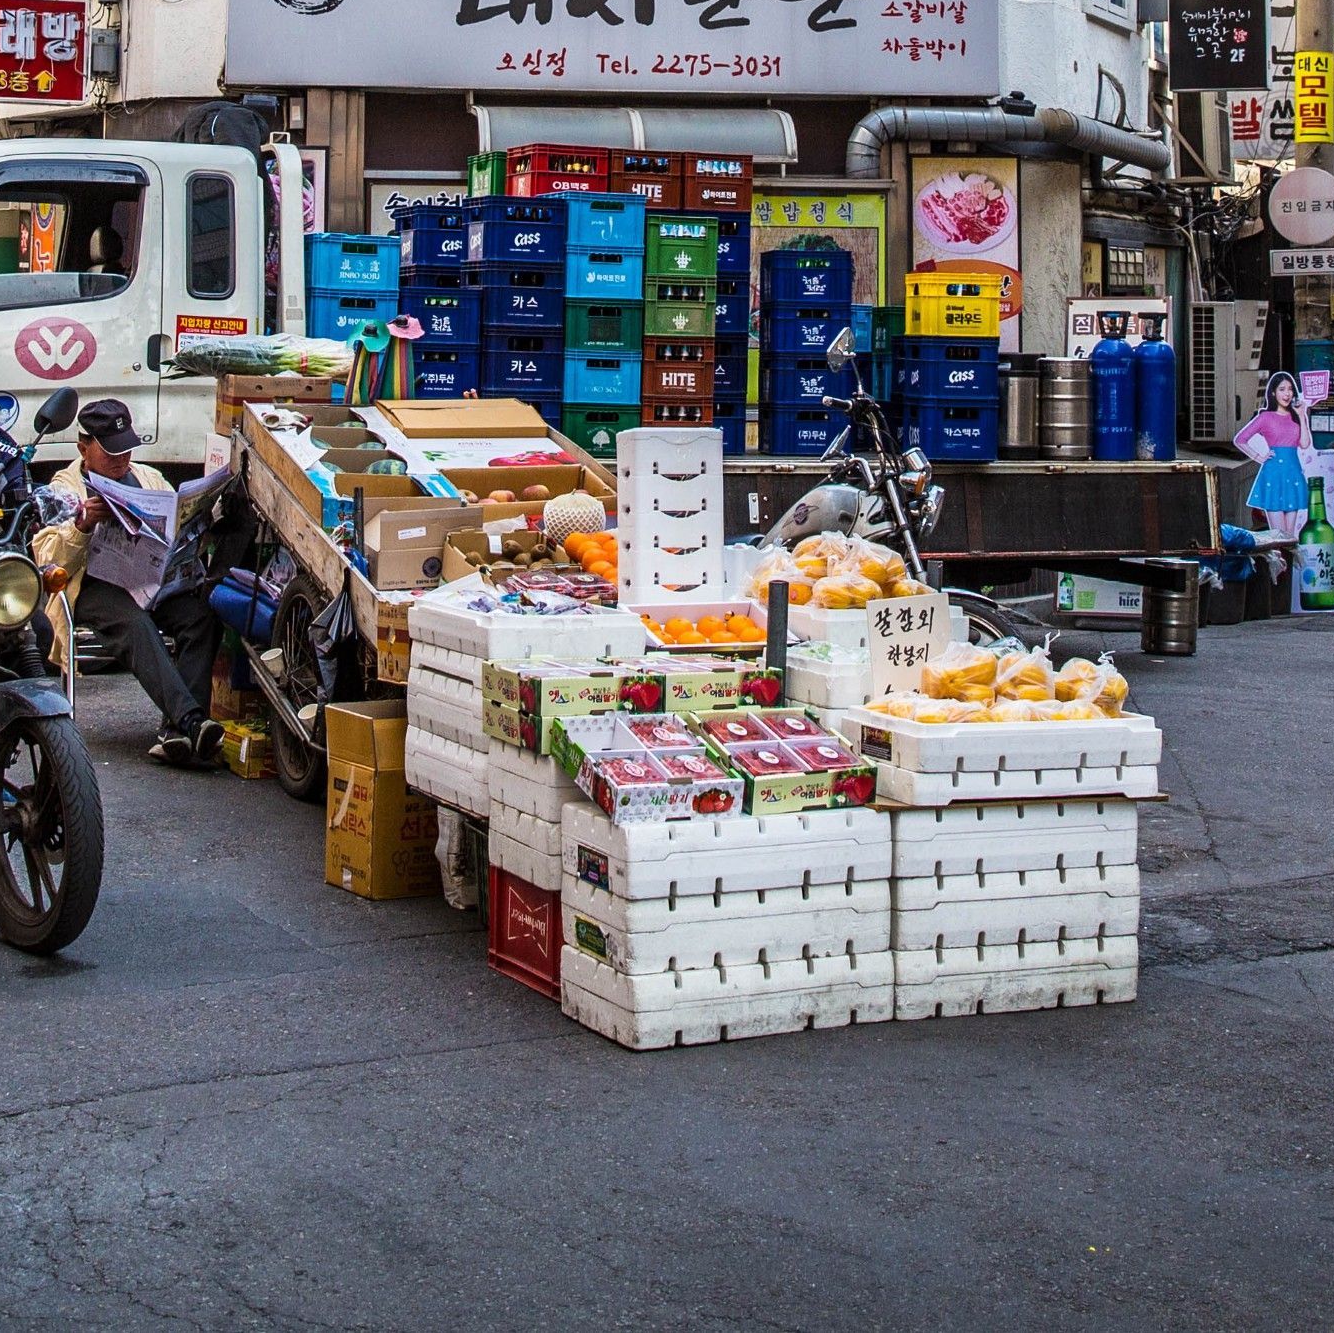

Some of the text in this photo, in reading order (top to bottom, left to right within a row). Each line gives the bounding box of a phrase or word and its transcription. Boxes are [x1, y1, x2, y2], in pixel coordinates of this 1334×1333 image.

[881, 35, 968, 62] 차돌박이
[1229, 49, 1246, 63] 2F
[495, 48, 783, 79] 오신정 Tel. 2275-3031
[1298, 56, 1330, 73] 대신
[1297, 75, 1331, 131] 모텔
[551, 180, 590, 192] OB맥주
[755, 201, 854, 224] 쌈밥정식
[513, 231, 541, 247] Cass
[512, 295, 539, 309] 카스
[180, 317, 244, 331] 지입차량 신고안내
[944, 312, 982, 325] 클라우드
[510, 359, 538, 373] 카스
[661, 371, 696, 387] HITE
[948, 369, 975, 384] Cass
[1118, 595, 1140, 609] hite
[886, 643, 930, 668] 한봉지
